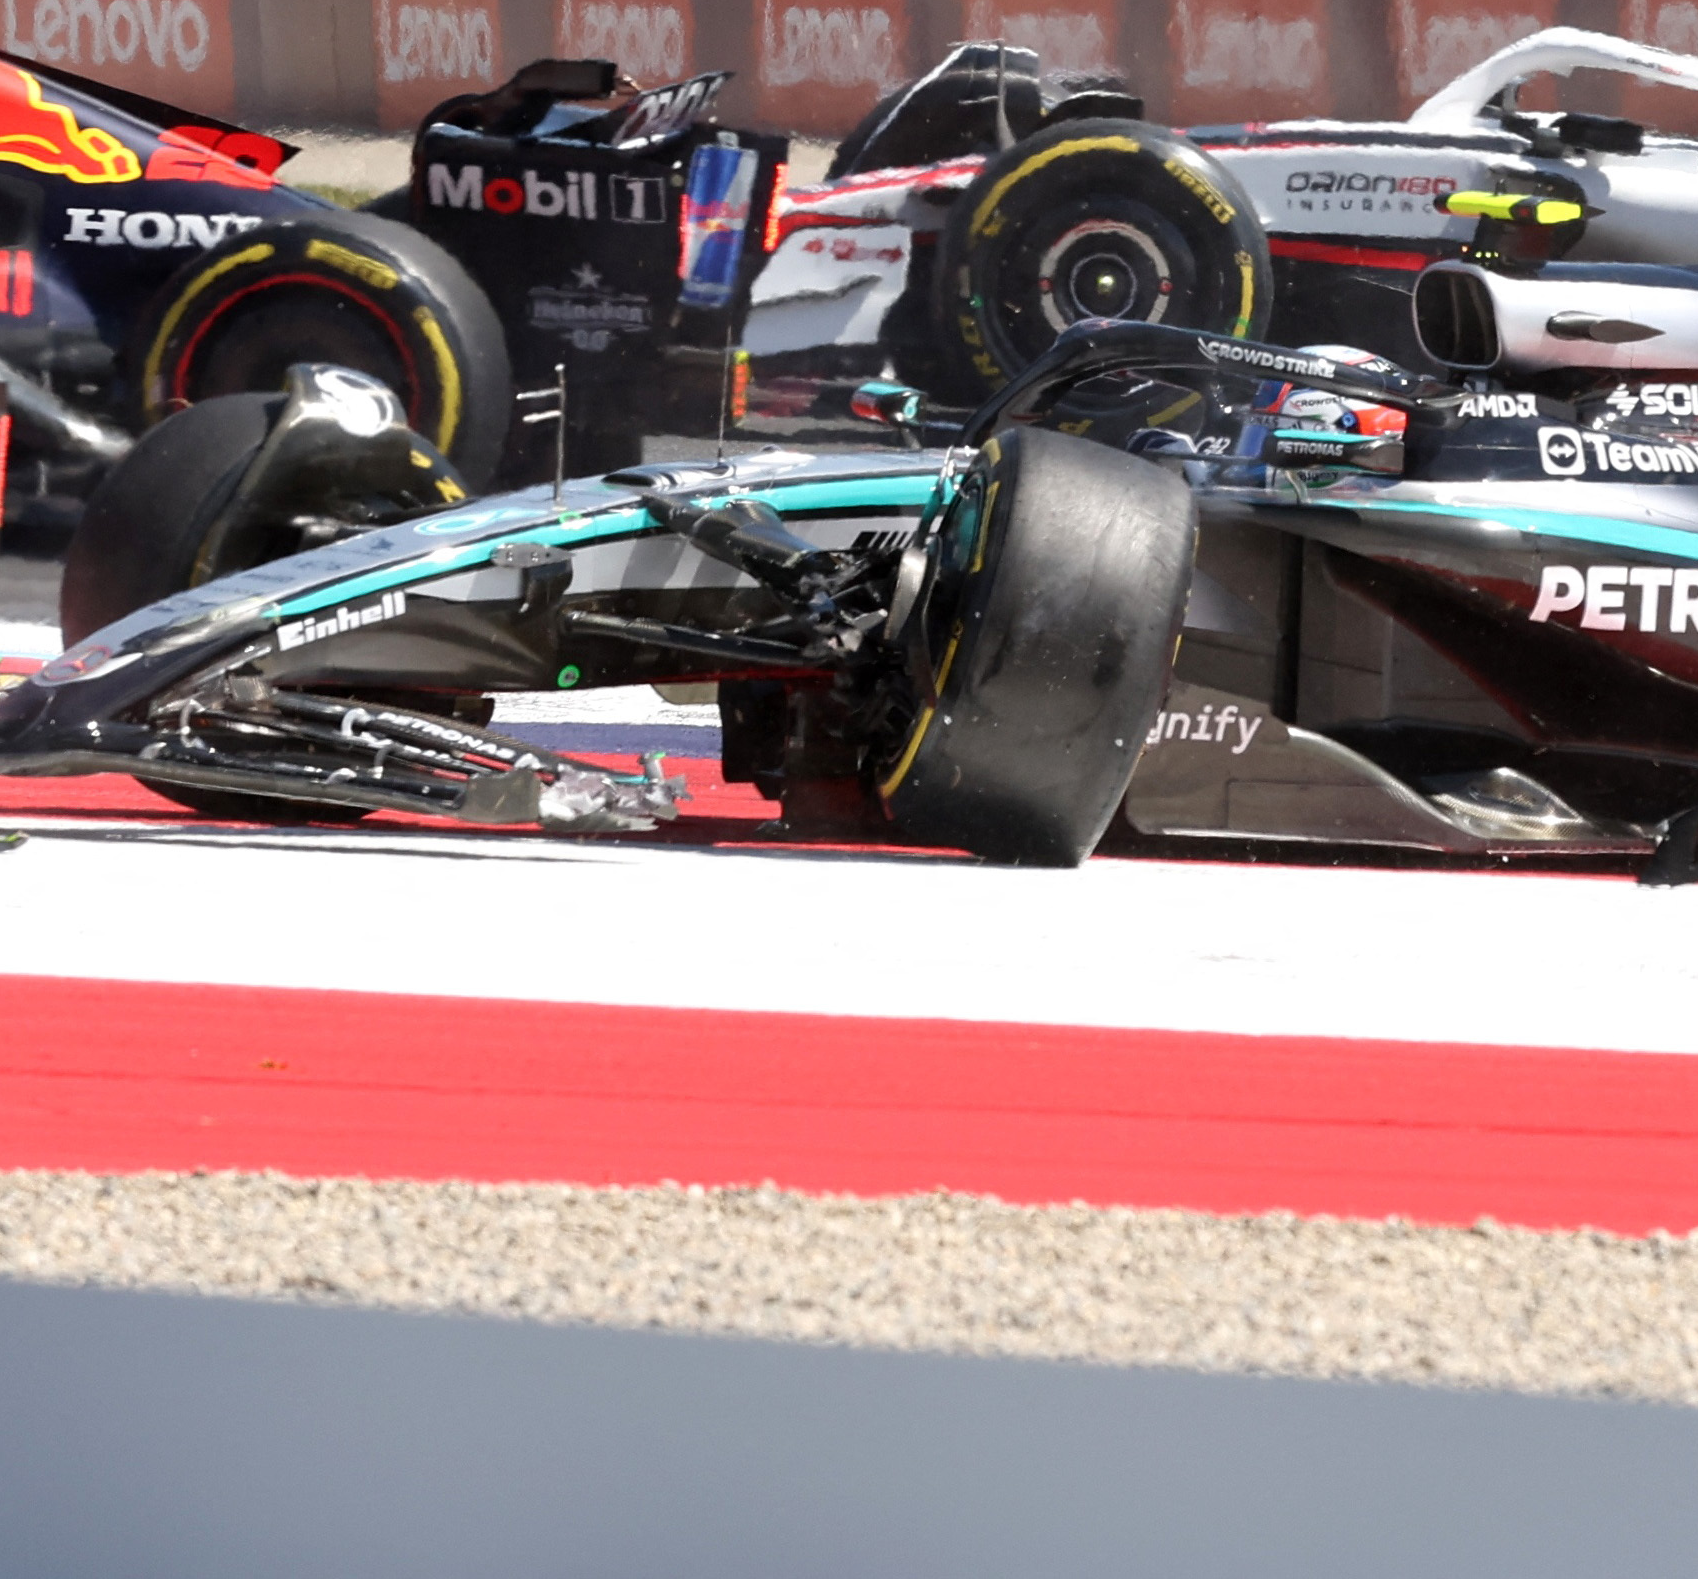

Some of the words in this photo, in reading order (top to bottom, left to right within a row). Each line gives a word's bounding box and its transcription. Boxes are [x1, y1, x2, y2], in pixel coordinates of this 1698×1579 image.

[428, 163, 597, 220] Mobil
[1286, 198, 1436, 215] INSURANC
[1206, 340, 1336, 379] CROWDSTRIKE
[1275, 441, 1344, 457] PETRONAS
[275, 590, 407, 652] Einhell
